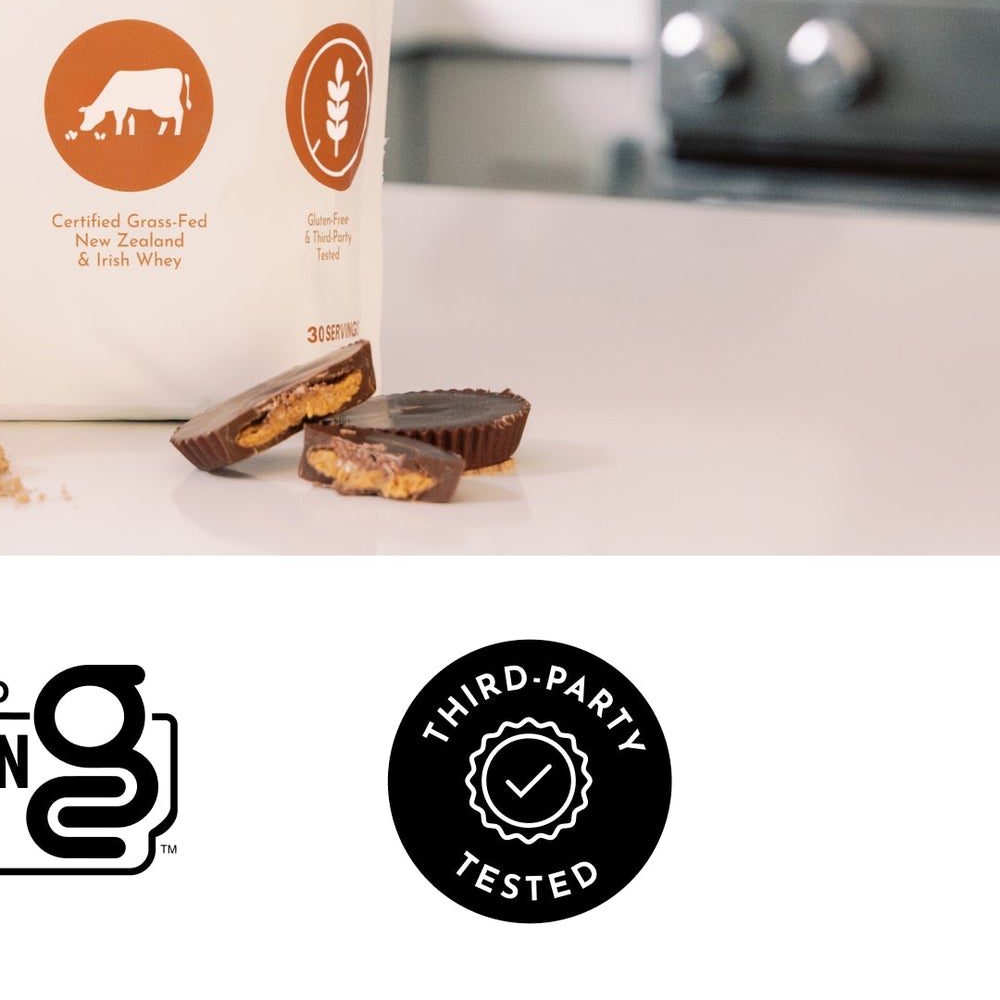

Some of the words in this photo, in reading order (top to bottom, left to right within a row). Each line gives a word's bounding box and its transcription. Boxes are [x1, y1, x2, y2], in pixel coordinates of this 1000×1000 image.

[52, 212, 120, 230] Certified
[127, 212, 208, 230] Grass-Fed
[307, 212, 349, 226] Gluten-Free
[75, 232, 112, 249] New
[118, 231, 185, 249] Zealand
[313, 229, 352, 245] Third-Party
[78, 252, 89, 266] &
[97, 251, 129, 266] Irish
[136, 250, 182, 270] Whey
[317, 247, 340, 260] Tested
